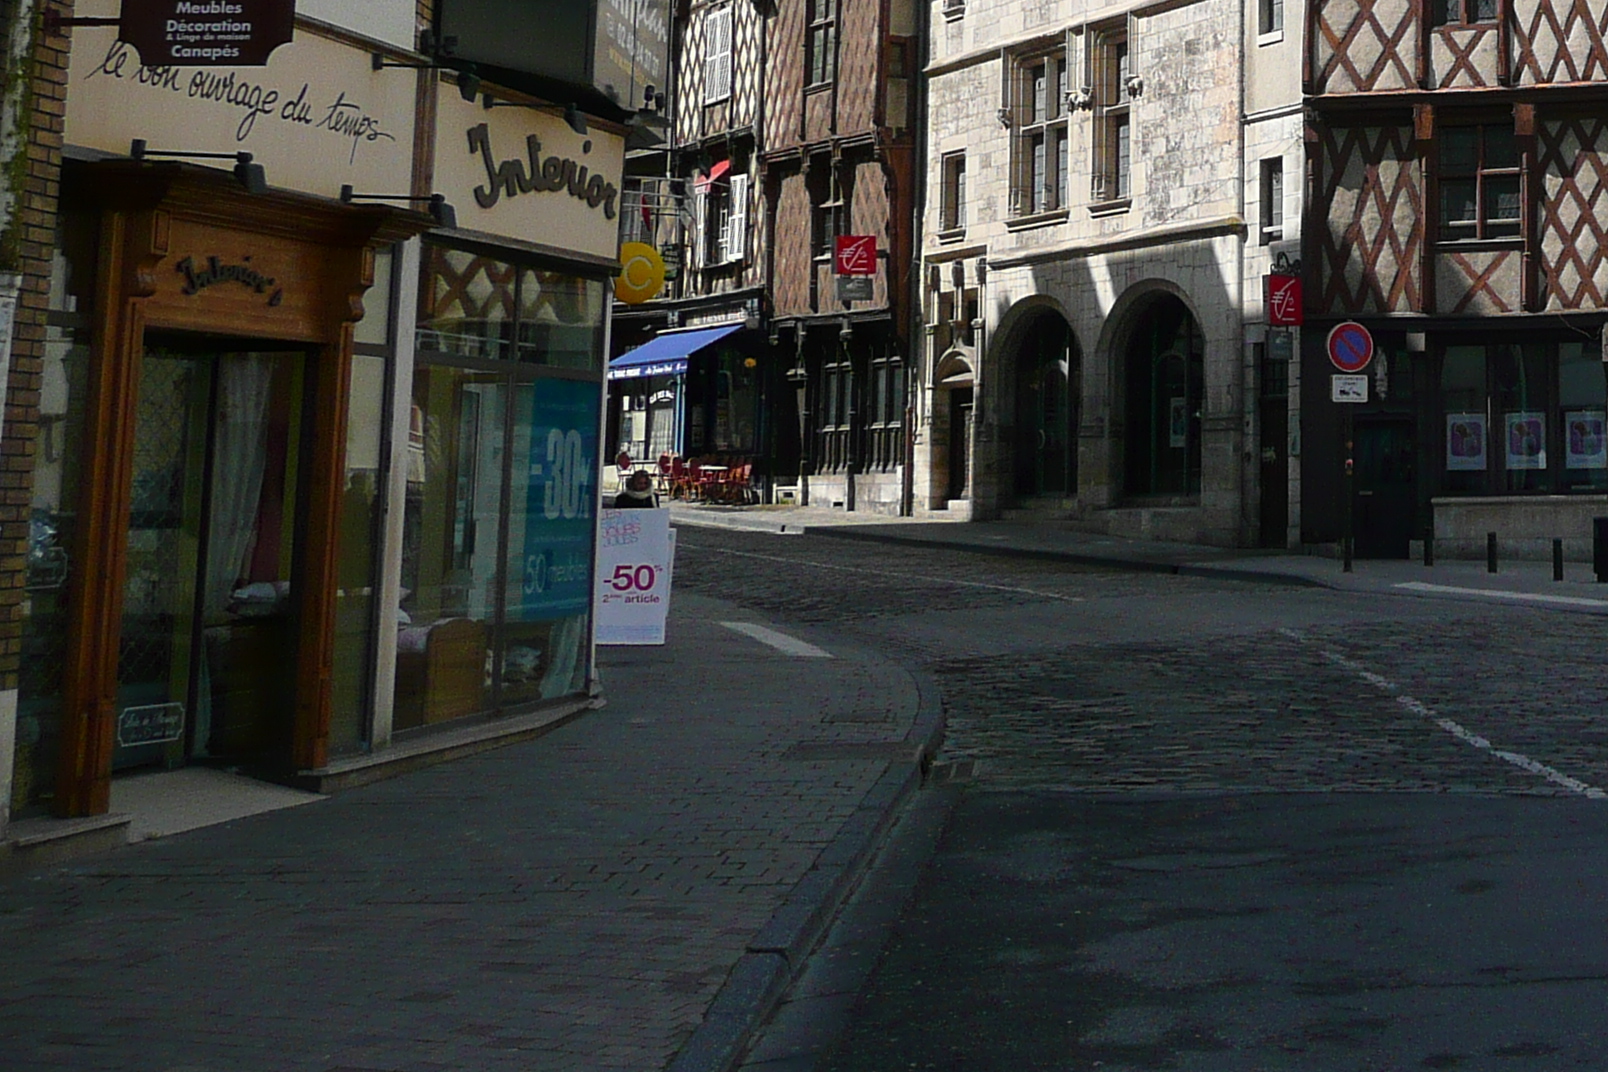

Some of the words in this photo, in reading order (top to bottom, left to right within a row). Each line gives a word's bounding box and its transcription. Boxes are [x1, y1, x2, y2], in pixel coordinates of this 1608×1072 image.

[176, 0, 242, 14] Meubles
[166, 19, 251, 32] Décoration
[176, 33, 200, 42] Linge
[171, 44, 239, 60] Canapés
[189, 70, 279, 141] ouvrage
[281, 83, 313, 124] du
[316, 92, 396, 166] temps
[466, 123, 617, 220] Interior
[525, 553, 546, 594] 50
[624, 593, 660, 604] article
